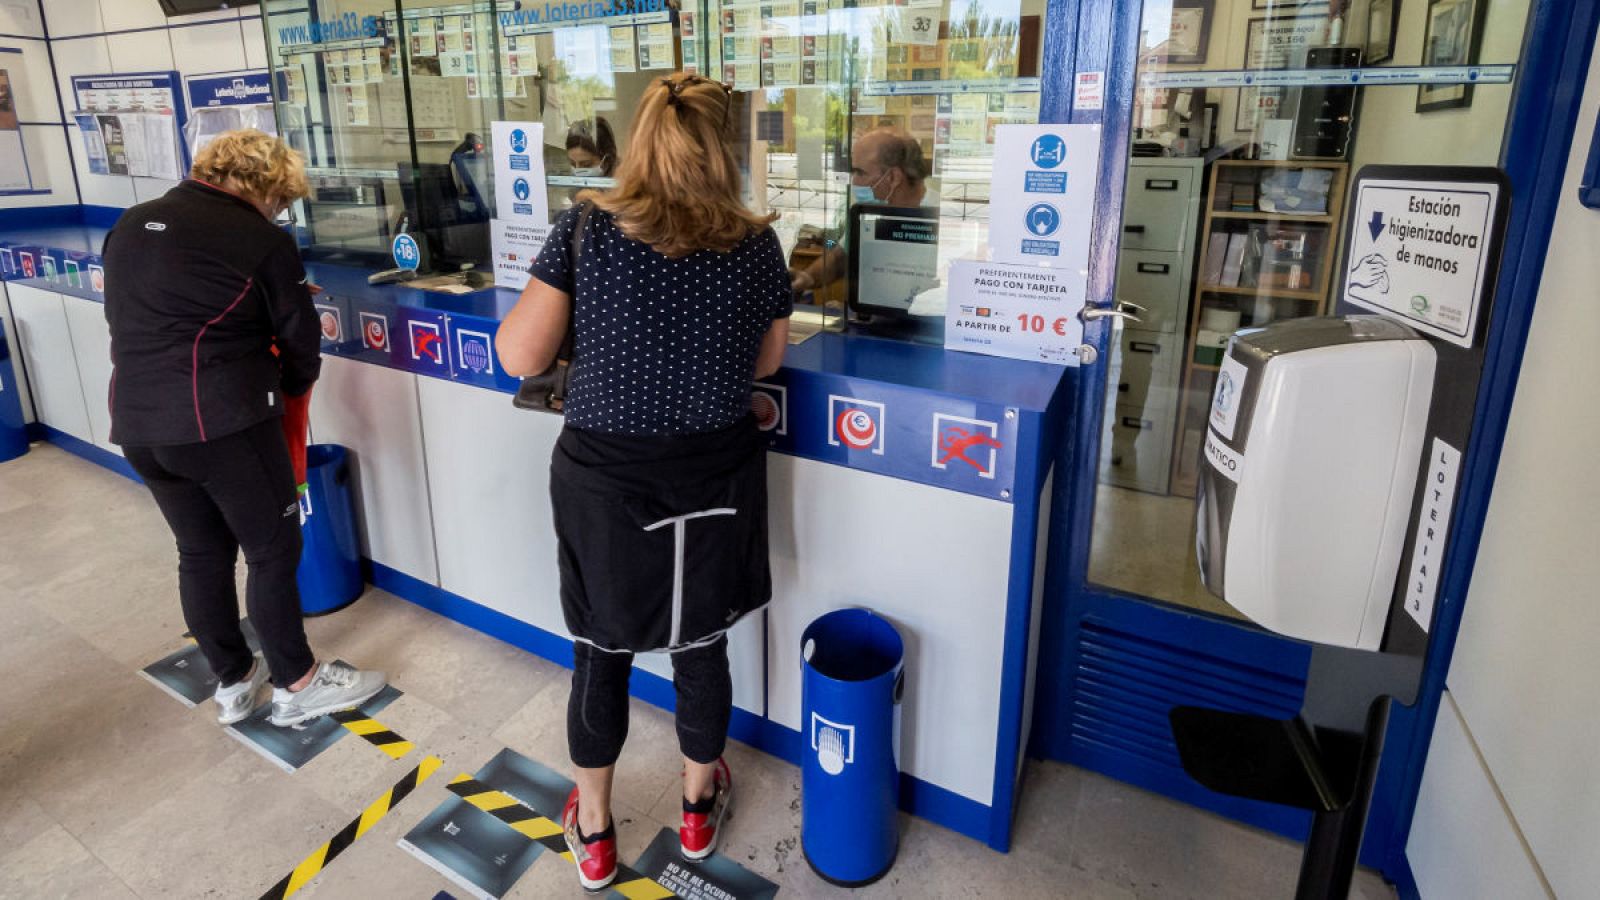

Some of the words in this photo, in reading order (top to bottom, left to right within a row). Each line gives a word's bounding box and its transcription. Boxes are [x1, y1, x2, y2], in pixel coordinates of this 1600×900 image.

[279, 12, 376, 44] www.loteria33.es
[1408, 195, 1461, 217] Estación
[1389, 216, 1478, 249] higienizadora
[1396, 244, 1410, 263] de
[1414, 253, 1459, 274] manos
[974, 278, 1001, 288] PAGO
[1003, 280, 1024, 289] CON
[1026, 283, 1068, 294] TARJETA
[979, 269, 1057, 281] PREFERENTEMENTE
[956, 320, 962, 328] A
[964, 320, 997, 332] PARTIR
[999, 324, 1012, 333] DE
[1017, 313, 1045, 333] 10
[1052, 317, 1068, 336] €
[657, 875, 677, 890] ECHA
[676, 887, 688, 897] LA
[666, 862, 680, 873] NO
[679, 870, 691, 880] SE
[689, 875, 705, 887] ME
